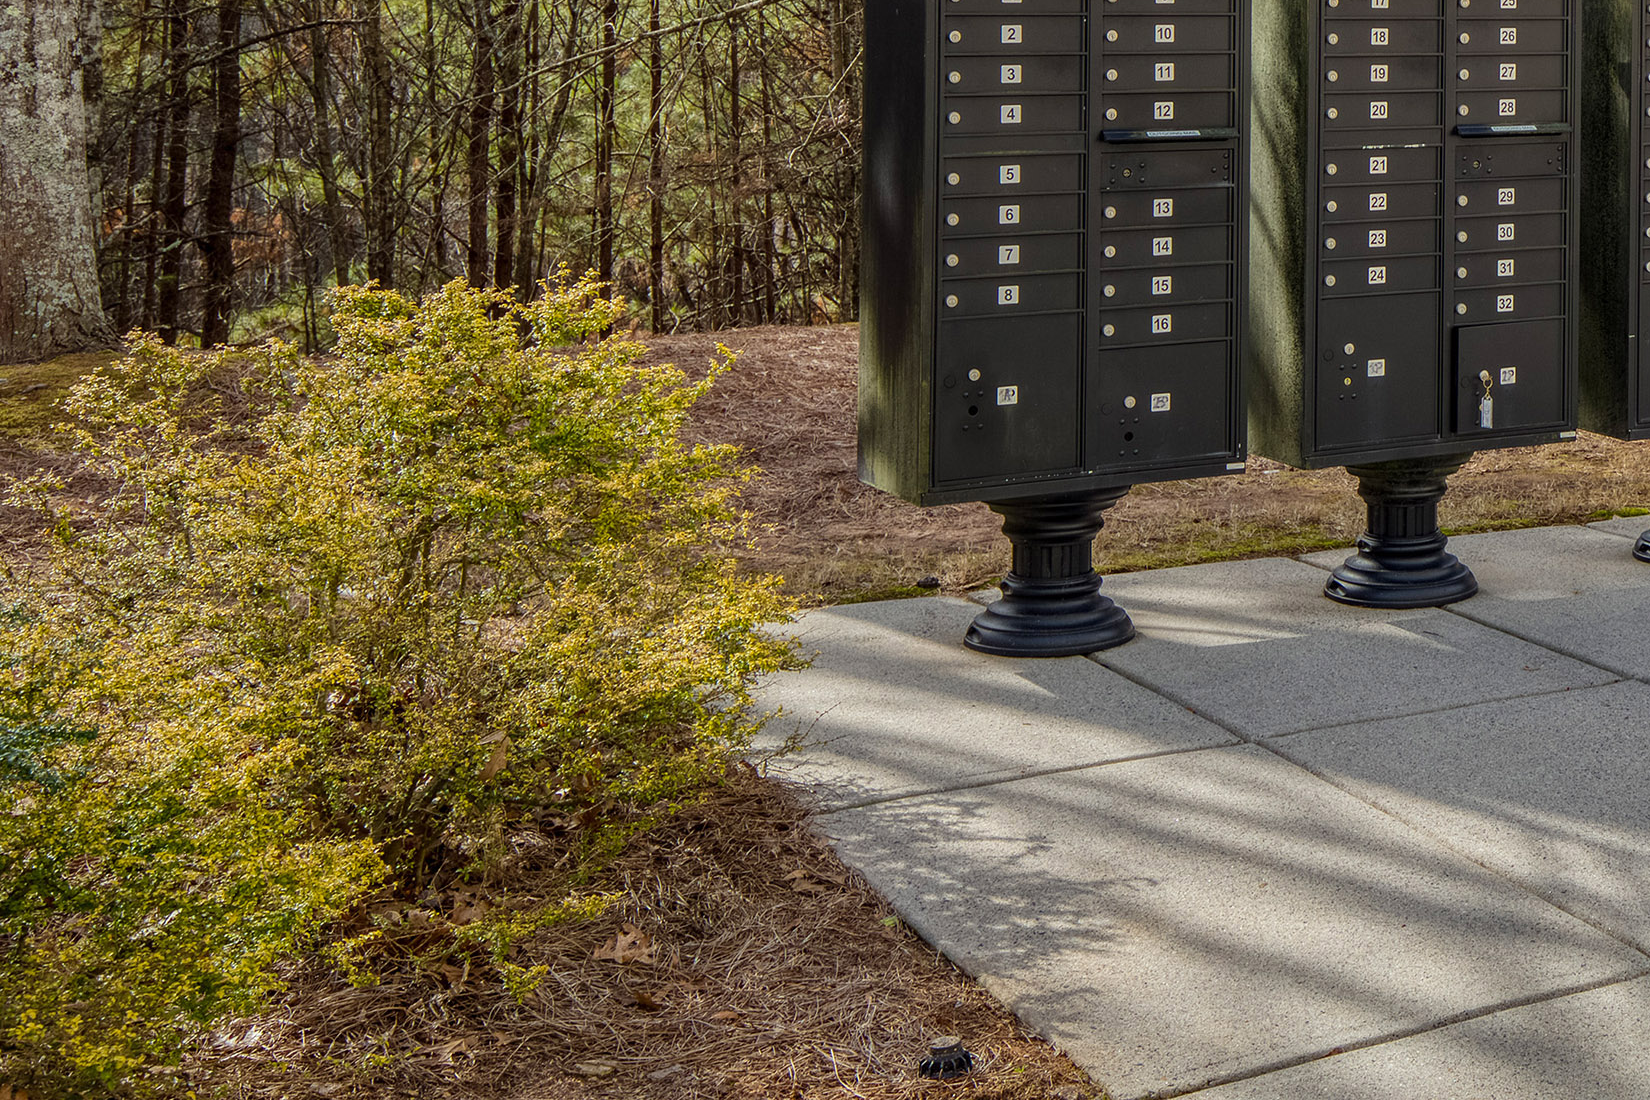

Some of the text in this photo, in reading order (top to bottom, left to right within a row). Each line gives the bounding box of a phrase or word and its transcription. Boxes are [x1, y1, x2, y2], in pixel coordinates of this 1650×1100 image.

[1007, 27, 1016, 41] 2
[1157, 27, 1172, 40] 10
[1373, 30, 1386, 43] 18
[1501, 30, 1515, 42] 26
[1007, 67, 1016, 81] 3
[1157, 65, 1171, 78] 11
[1372, 67, 1386, 80] 19
[1501, 66, 1515, 78] 27
[1006, 107, 1016, 120] 4
[1156, 104, 1171, 117] 12
[1372, 104, 1386, 116] 20
[1500, 101, 1514, 113] 28
[1372, 159, 1385, 171] 21
[1006, 167, 1015, 181] 5
[1371, 196, 1385, 208] 22
[1499, 190, 1513, 203] 29
[1155, 201, 1170, 214] 13
[1005, 208, 1014, 221] 6
[1370, 232, 1385, 245] 23
[1499, 226, 1513, 239] 30
[1155, 240, 1170, 253] 14
[1005, 248, 1014, 261] 7
[1499, 262, 1512, 274] 31
[1370, 269, 1384, 282] 24
[1154, 279, 1169, 292] 15
[1004, 288, 1013, 302] 8
[1498, 297, 1512, 310] 32
[1154, 317, 1169, 331] 16
